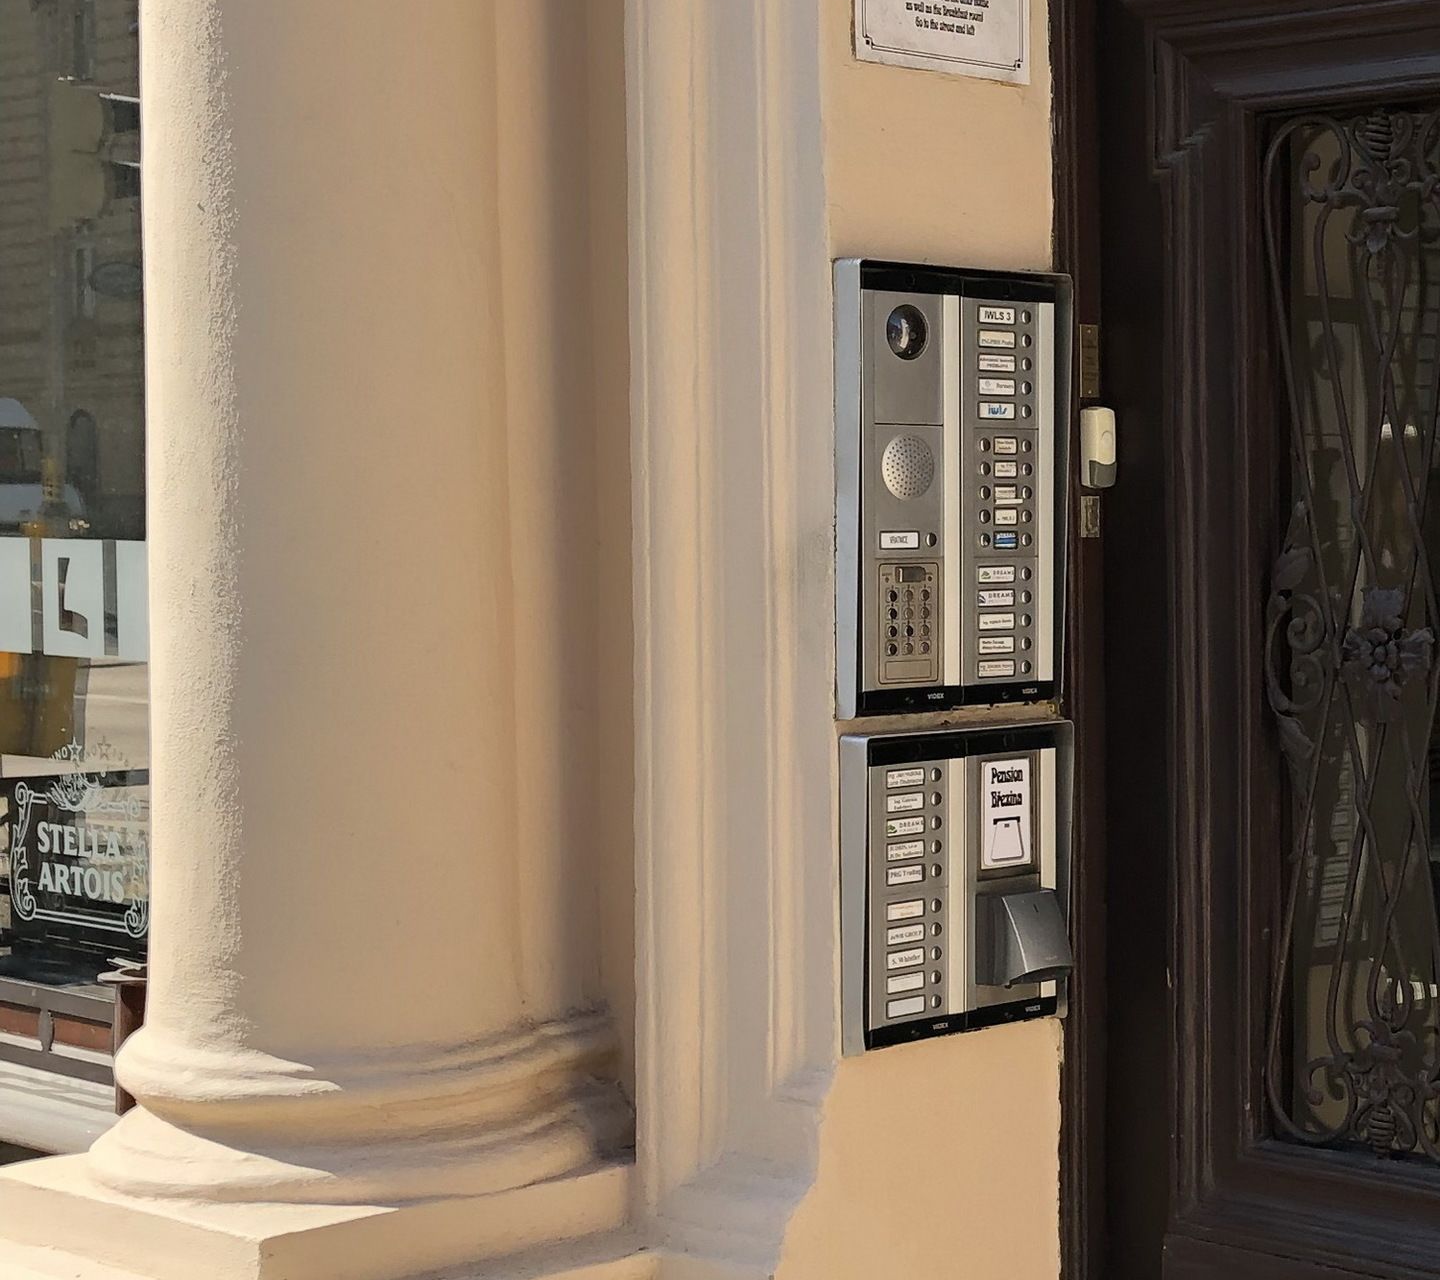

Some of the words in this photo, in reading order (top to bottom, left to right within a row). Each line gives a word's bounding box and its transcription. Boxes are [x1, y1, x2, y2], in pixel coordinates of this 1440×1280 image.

[927, 692, 945, 700] VIDEX
[990, 766, 1023, 784] Pension
[37, 821, 121, 859] STELLA
[38, 861, 126, 904] ARTOIS
